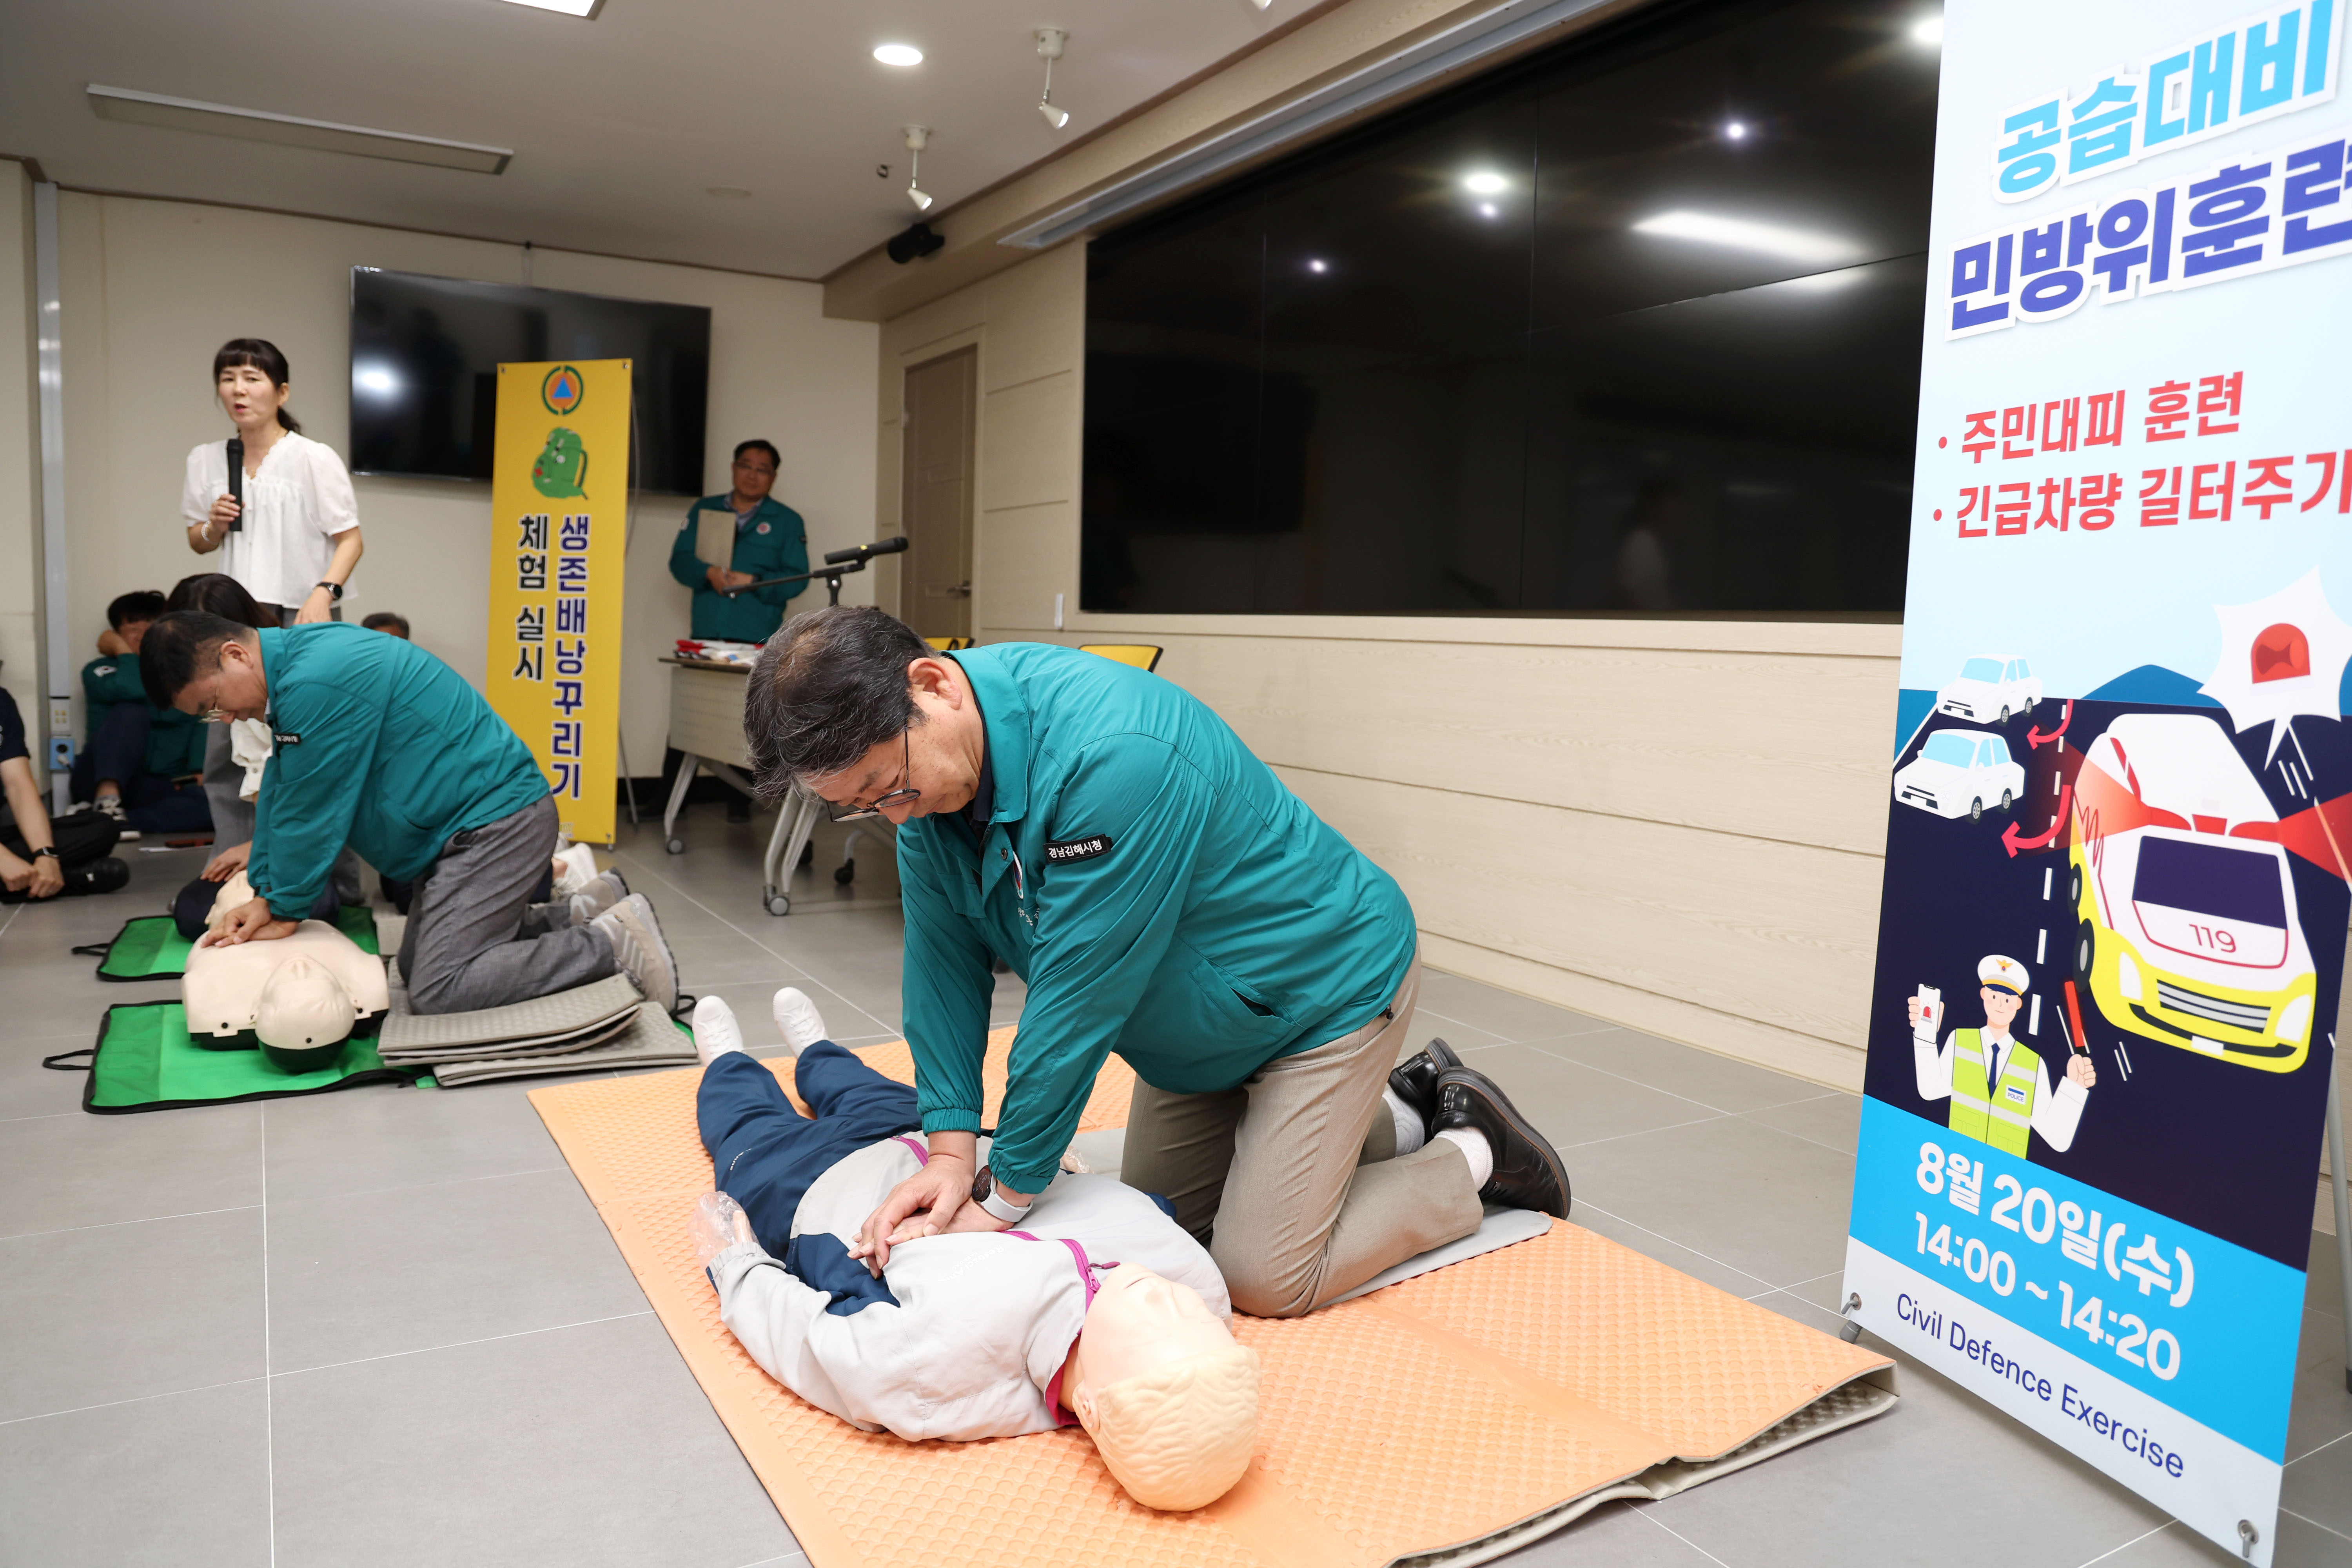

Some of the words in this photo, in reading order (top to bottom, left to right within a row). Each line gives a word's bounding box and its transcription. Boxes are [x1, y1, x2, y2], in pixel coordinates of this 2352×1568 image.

[1999, 0, 2333, 193] 공습대비
[1962, 390, 2125, 464] 주민대피
[2145, 371, 2243, 443] 훈련
[1957, 473, 2123, 537] 긴급차량
[2139, 450, 2352, 527] 길터주기
[519, 515, 548, 589] 체험
[515, 607, 543, 681] 실시
[551, 516, 588, 798] 생존배낭꾸리기
[1048, 839, 1102, 858] 경남김해시청
[2189, 924, 2236, 953] 119
[2008, 1092, 2024, 1102] POLICE
[1916, 1142, 1984, 1216] 8월
[1990, 1174, 2194, 1308] 20일(수)
[1915, 1211, 2016, 1296] 14:00
[2058, 1280, 2181, 1381] 14:20
[1897, 1294, 1942, 1339] Civil
[1950, 1321, 2051, 1401] Defence
[2062, 1384, 2183, 1478] Exercise
